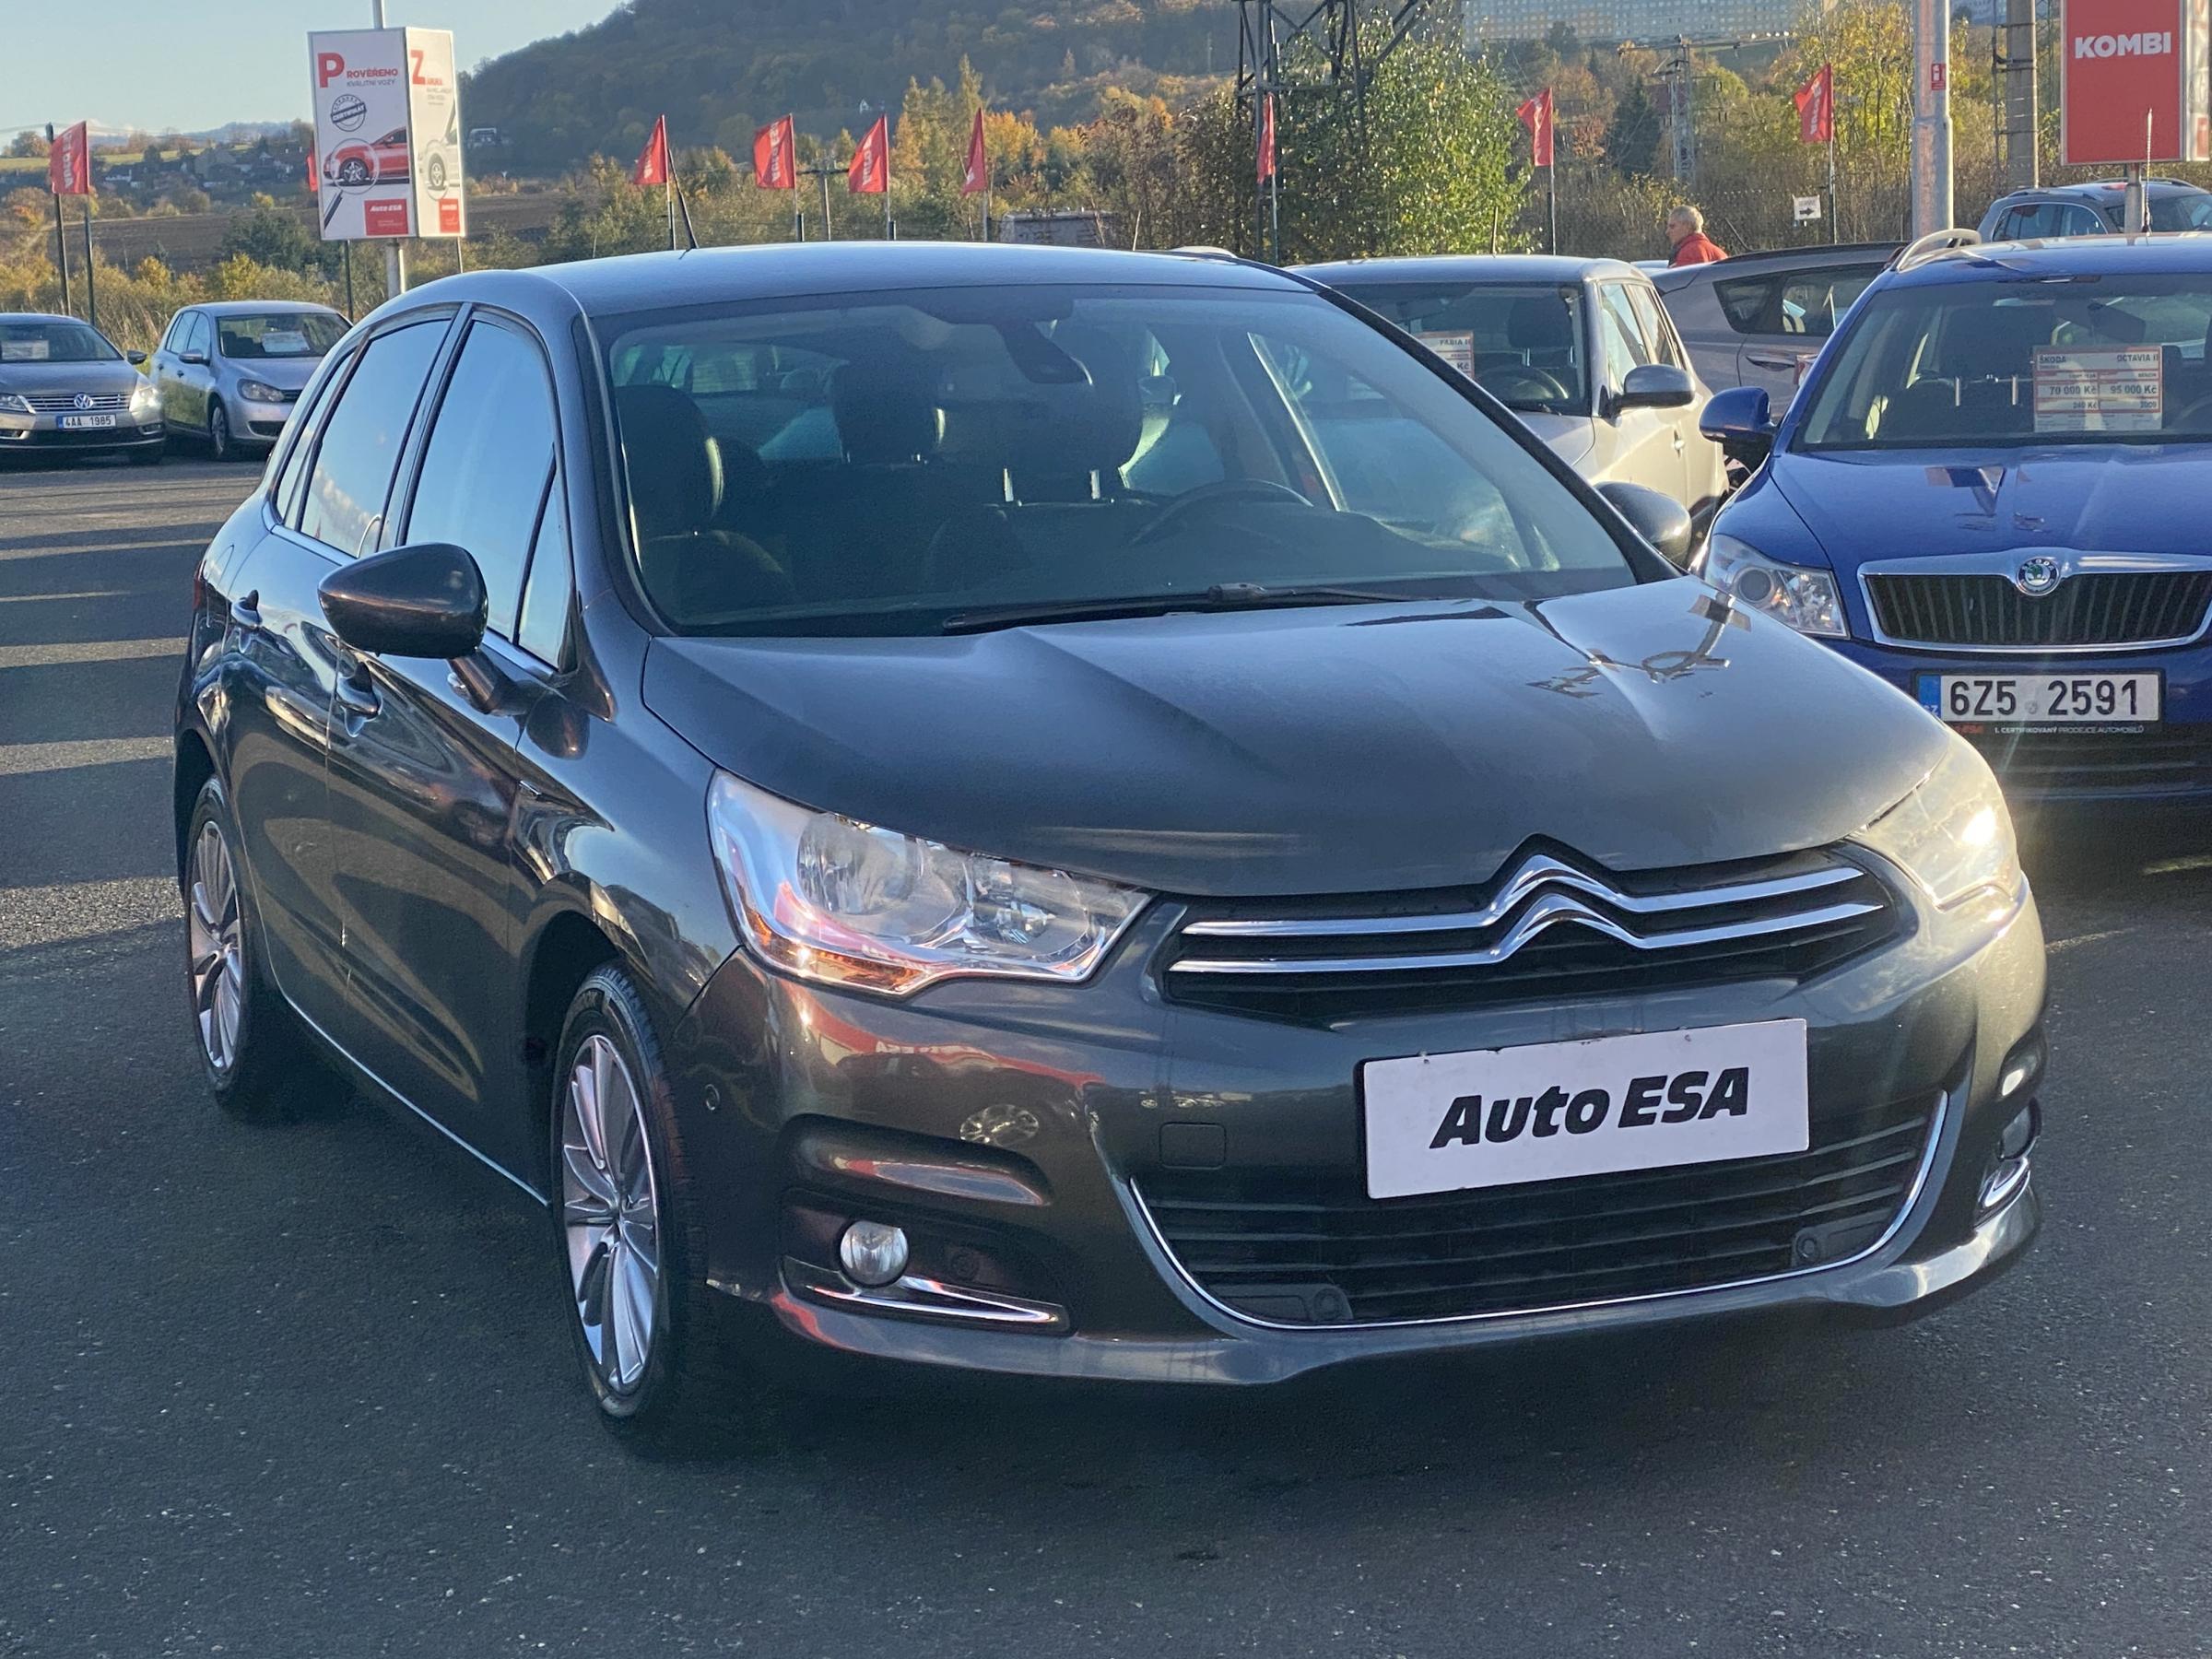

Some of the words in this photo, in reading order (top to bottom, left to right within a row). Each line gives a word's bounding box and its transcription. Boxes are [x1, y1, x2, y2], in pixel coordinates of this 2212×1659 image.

[2075, 32, 2171, 59] KOMBI
[2117, 354, 2150, 362] OCTAVIA
[2124, 384, 2142, 394] 000
[2145, 383, 2157, 394] Kč
[89, 415, 111, 425] 1985
[1949, 680, 2017, 715] 6Z5
[2048, 679, 2136, 715] 2591
[1429, 1086, 1611, 1149] Auto
[1618, 1066, 1749, 1128] ESA
